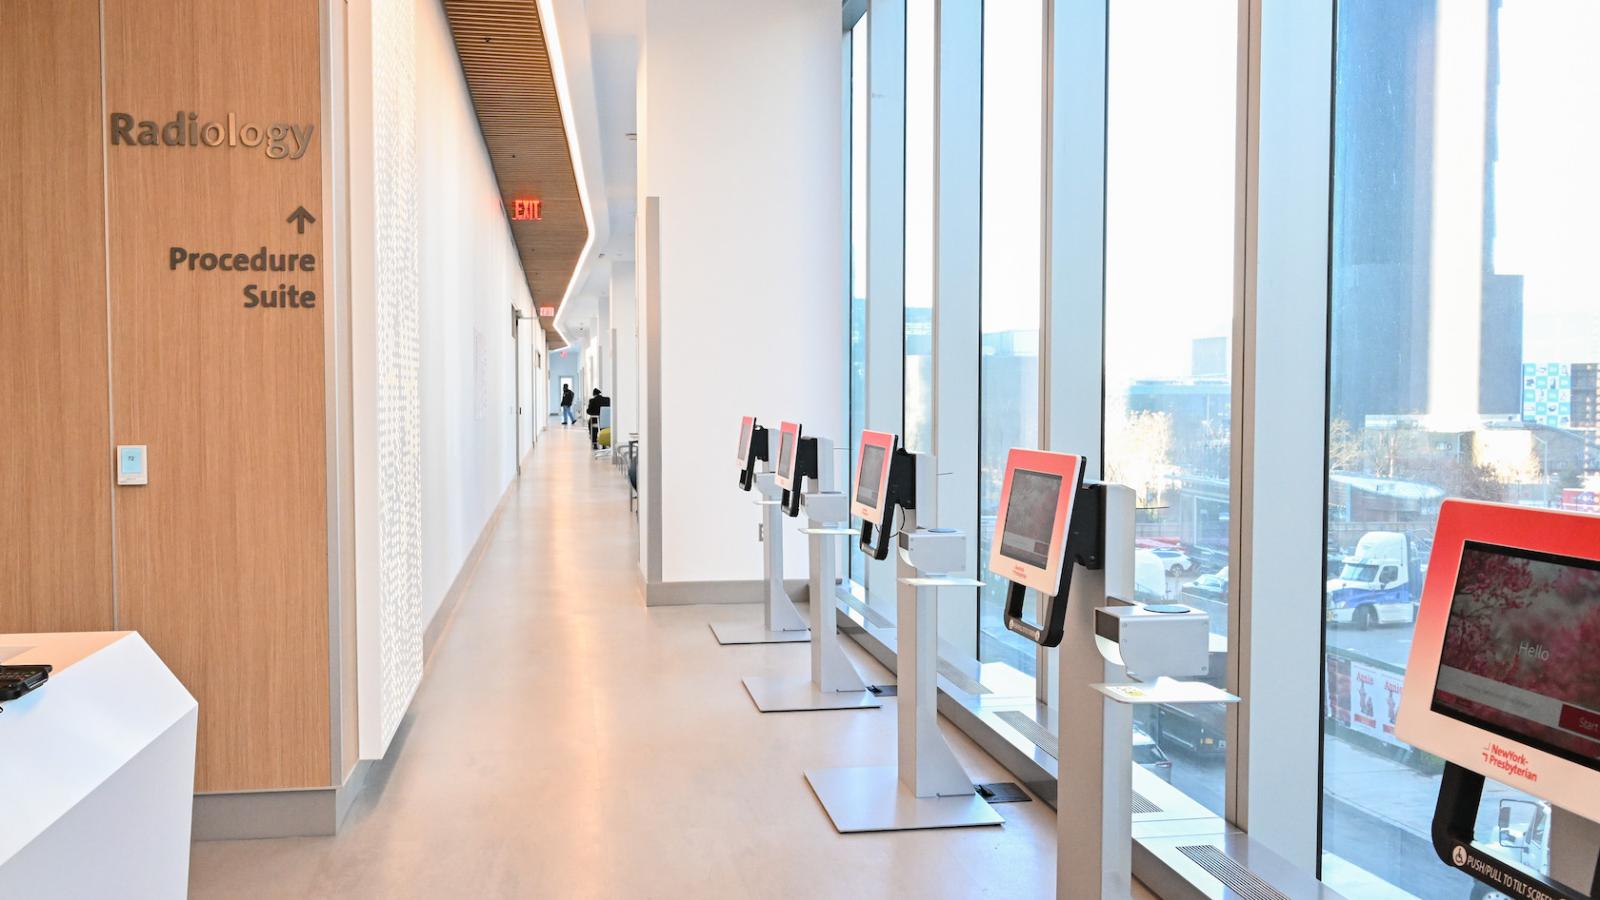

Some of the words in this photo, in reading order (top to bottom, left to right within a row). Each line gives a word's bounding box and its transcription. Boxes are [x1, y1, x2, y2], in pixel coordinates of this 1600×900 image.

[110, 111, 315, 160] Radiology
[514, 199, 540, 219] EXIT
[169, 246, 316, 272] Procedure
[242, 283, 316, 309] Suite
[1518, 640, 1550, 662] Hello
[1578, 716, 1599, 732] Start
[1490, 744, 1529, 765] NewYork-
[1489, 754, 1538, 782] Presbyterian
[1466, 855, 1502, 883] PUSH/PULL
[1503, 873, 1513, 888] TO
[1513, 878, 1528, 895] TILT
[1527, 886, 1554, 900] SCRE
